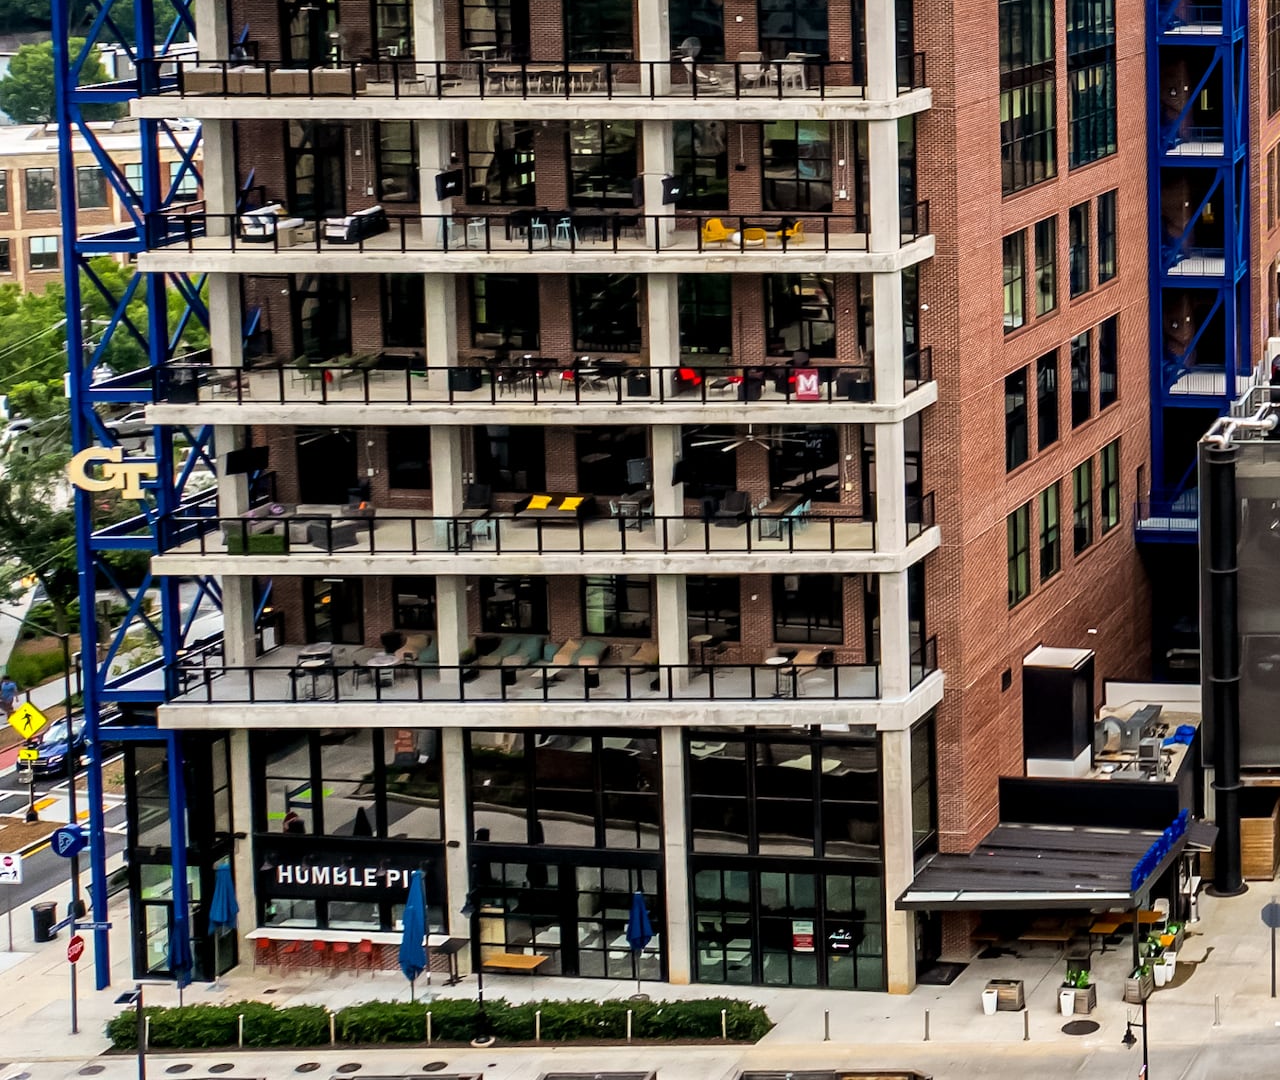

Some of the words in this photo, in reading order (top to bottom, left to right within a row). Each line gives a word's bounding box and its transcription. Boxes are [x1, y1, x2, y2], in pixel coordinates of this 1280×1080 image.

[798, 374, 819, 394] M
[65, 445, 158, 500] GT
[277, 864, 378, 887] HUMBLE
[386, 869, 416, 888] PI
